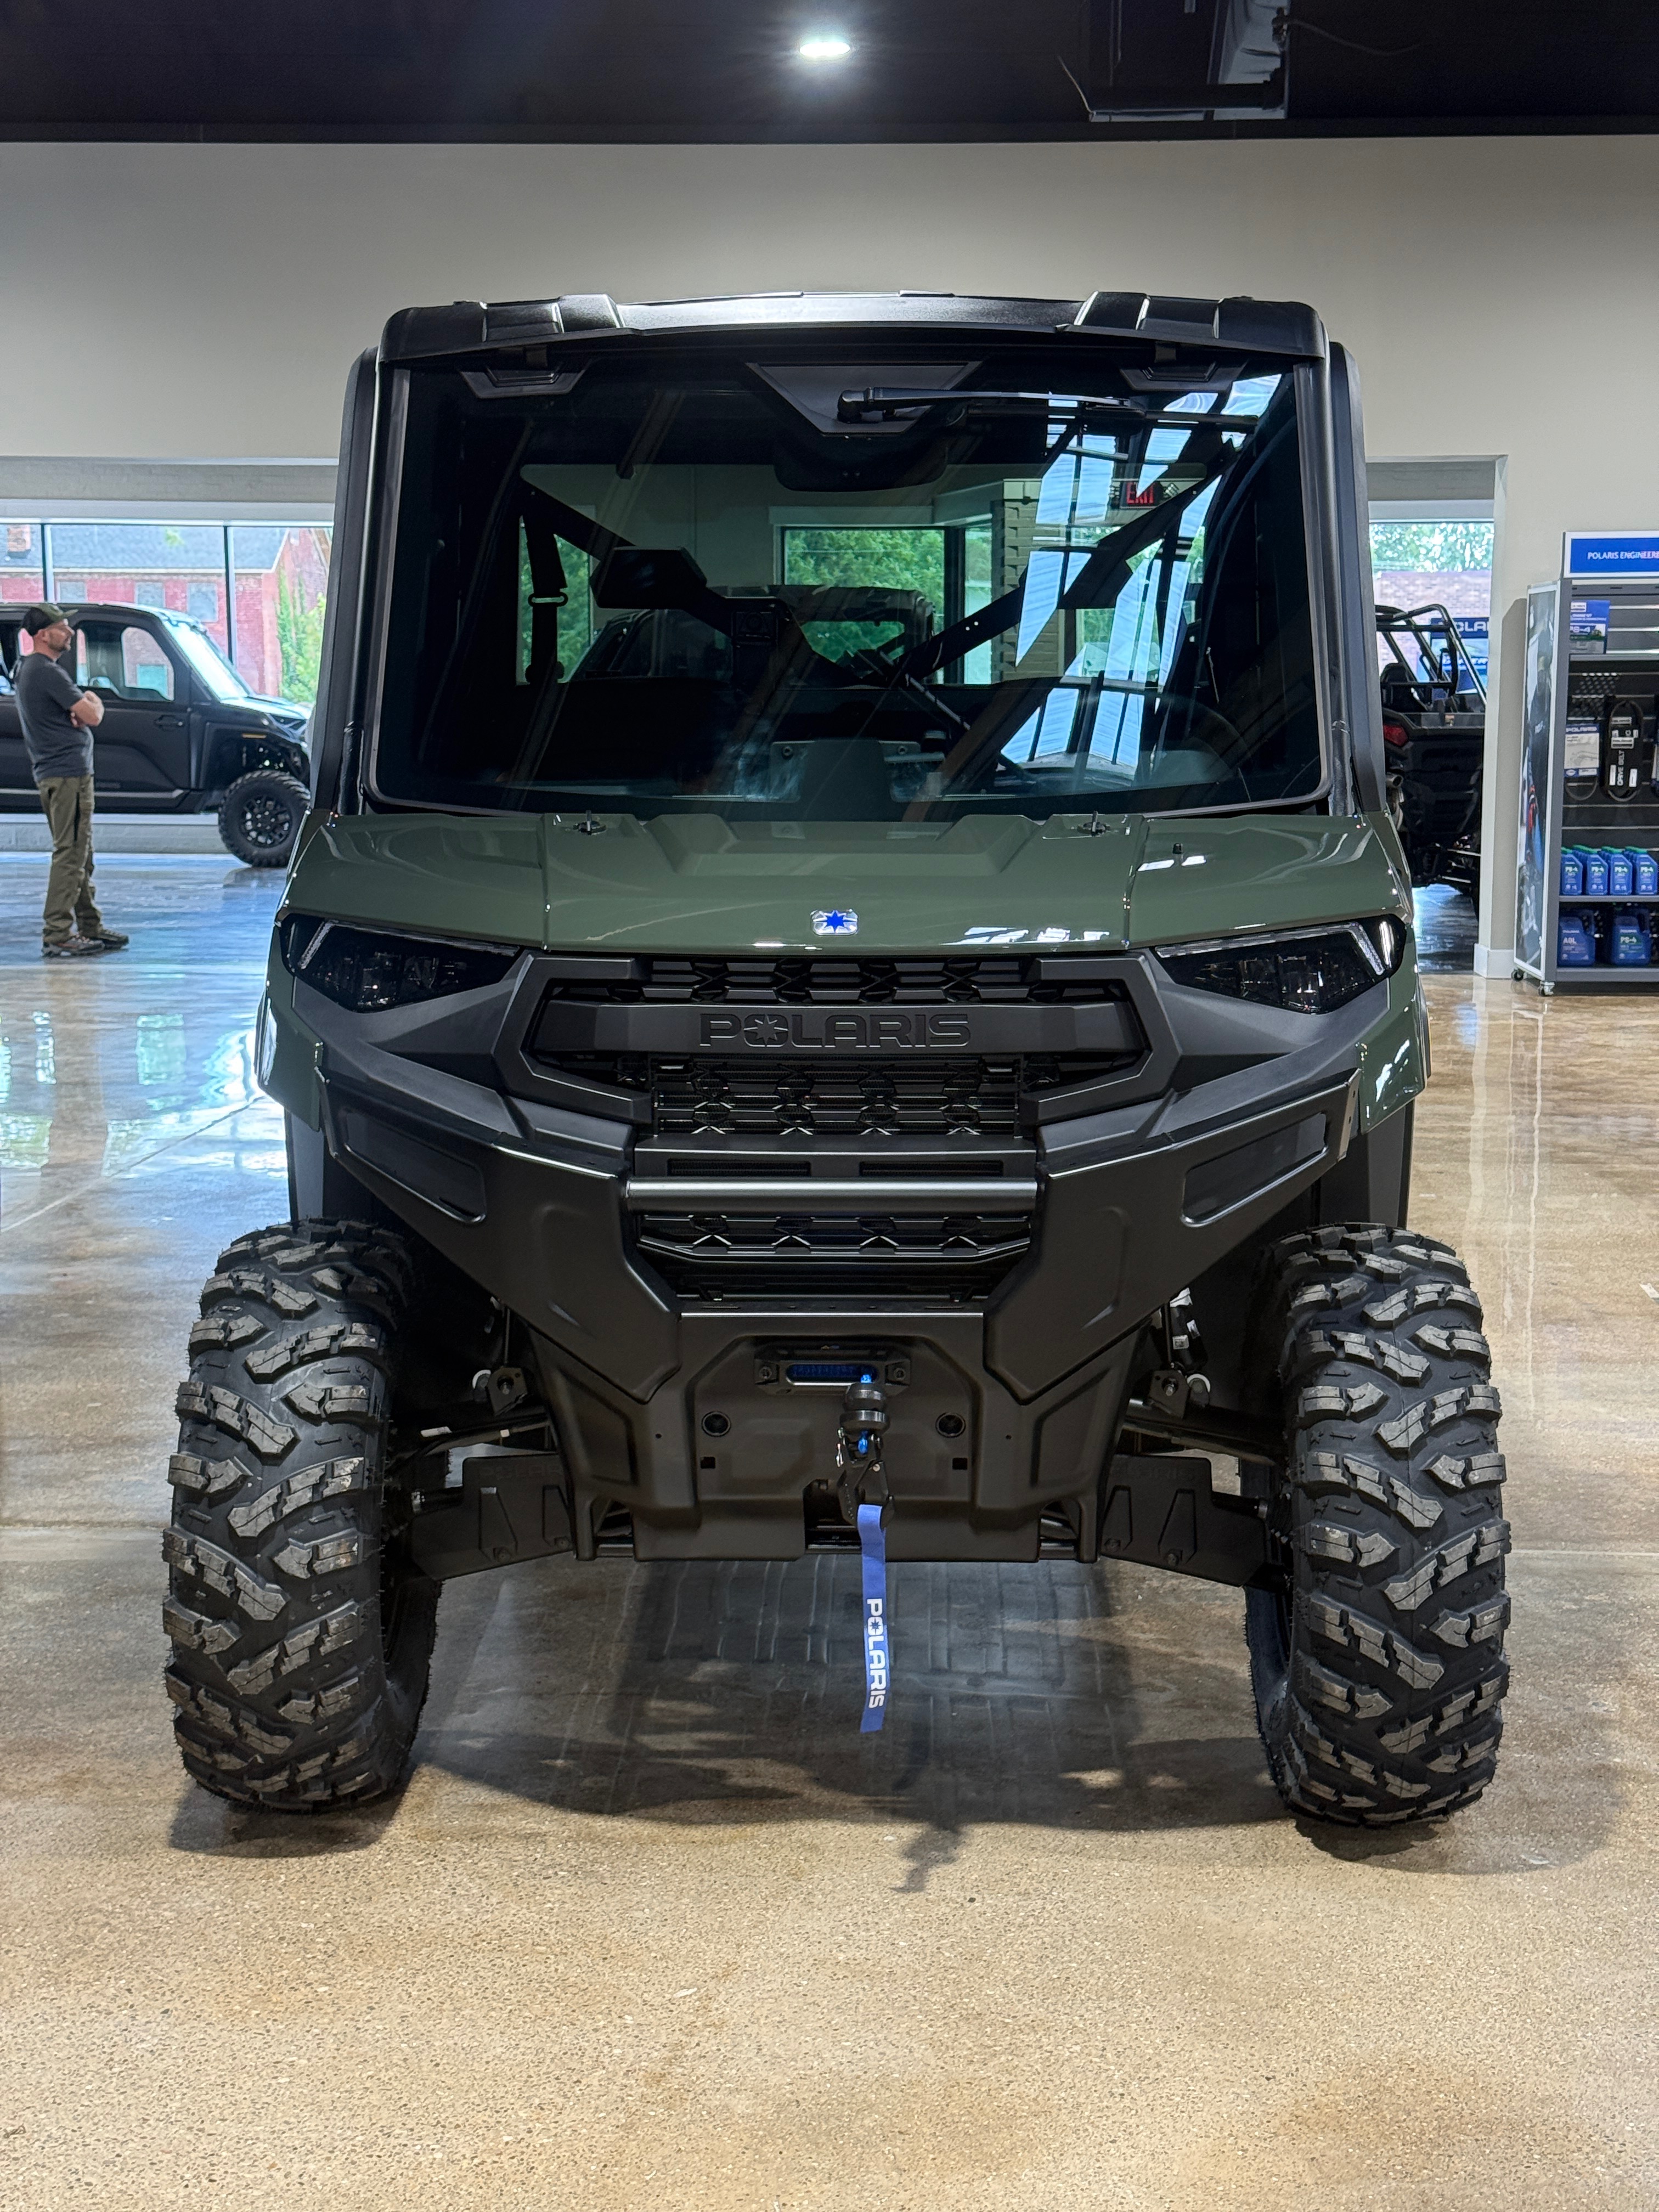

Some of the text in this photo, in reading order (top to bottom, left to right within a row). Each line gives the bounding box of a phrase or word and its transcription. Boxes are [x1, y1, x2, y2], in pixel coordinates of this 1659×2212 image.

[1587, 551, 1619, 560] POLARIS
[699, 1013, 971, 1048] POLARIS
[867, 1598, 887, 1708] POLARIS
